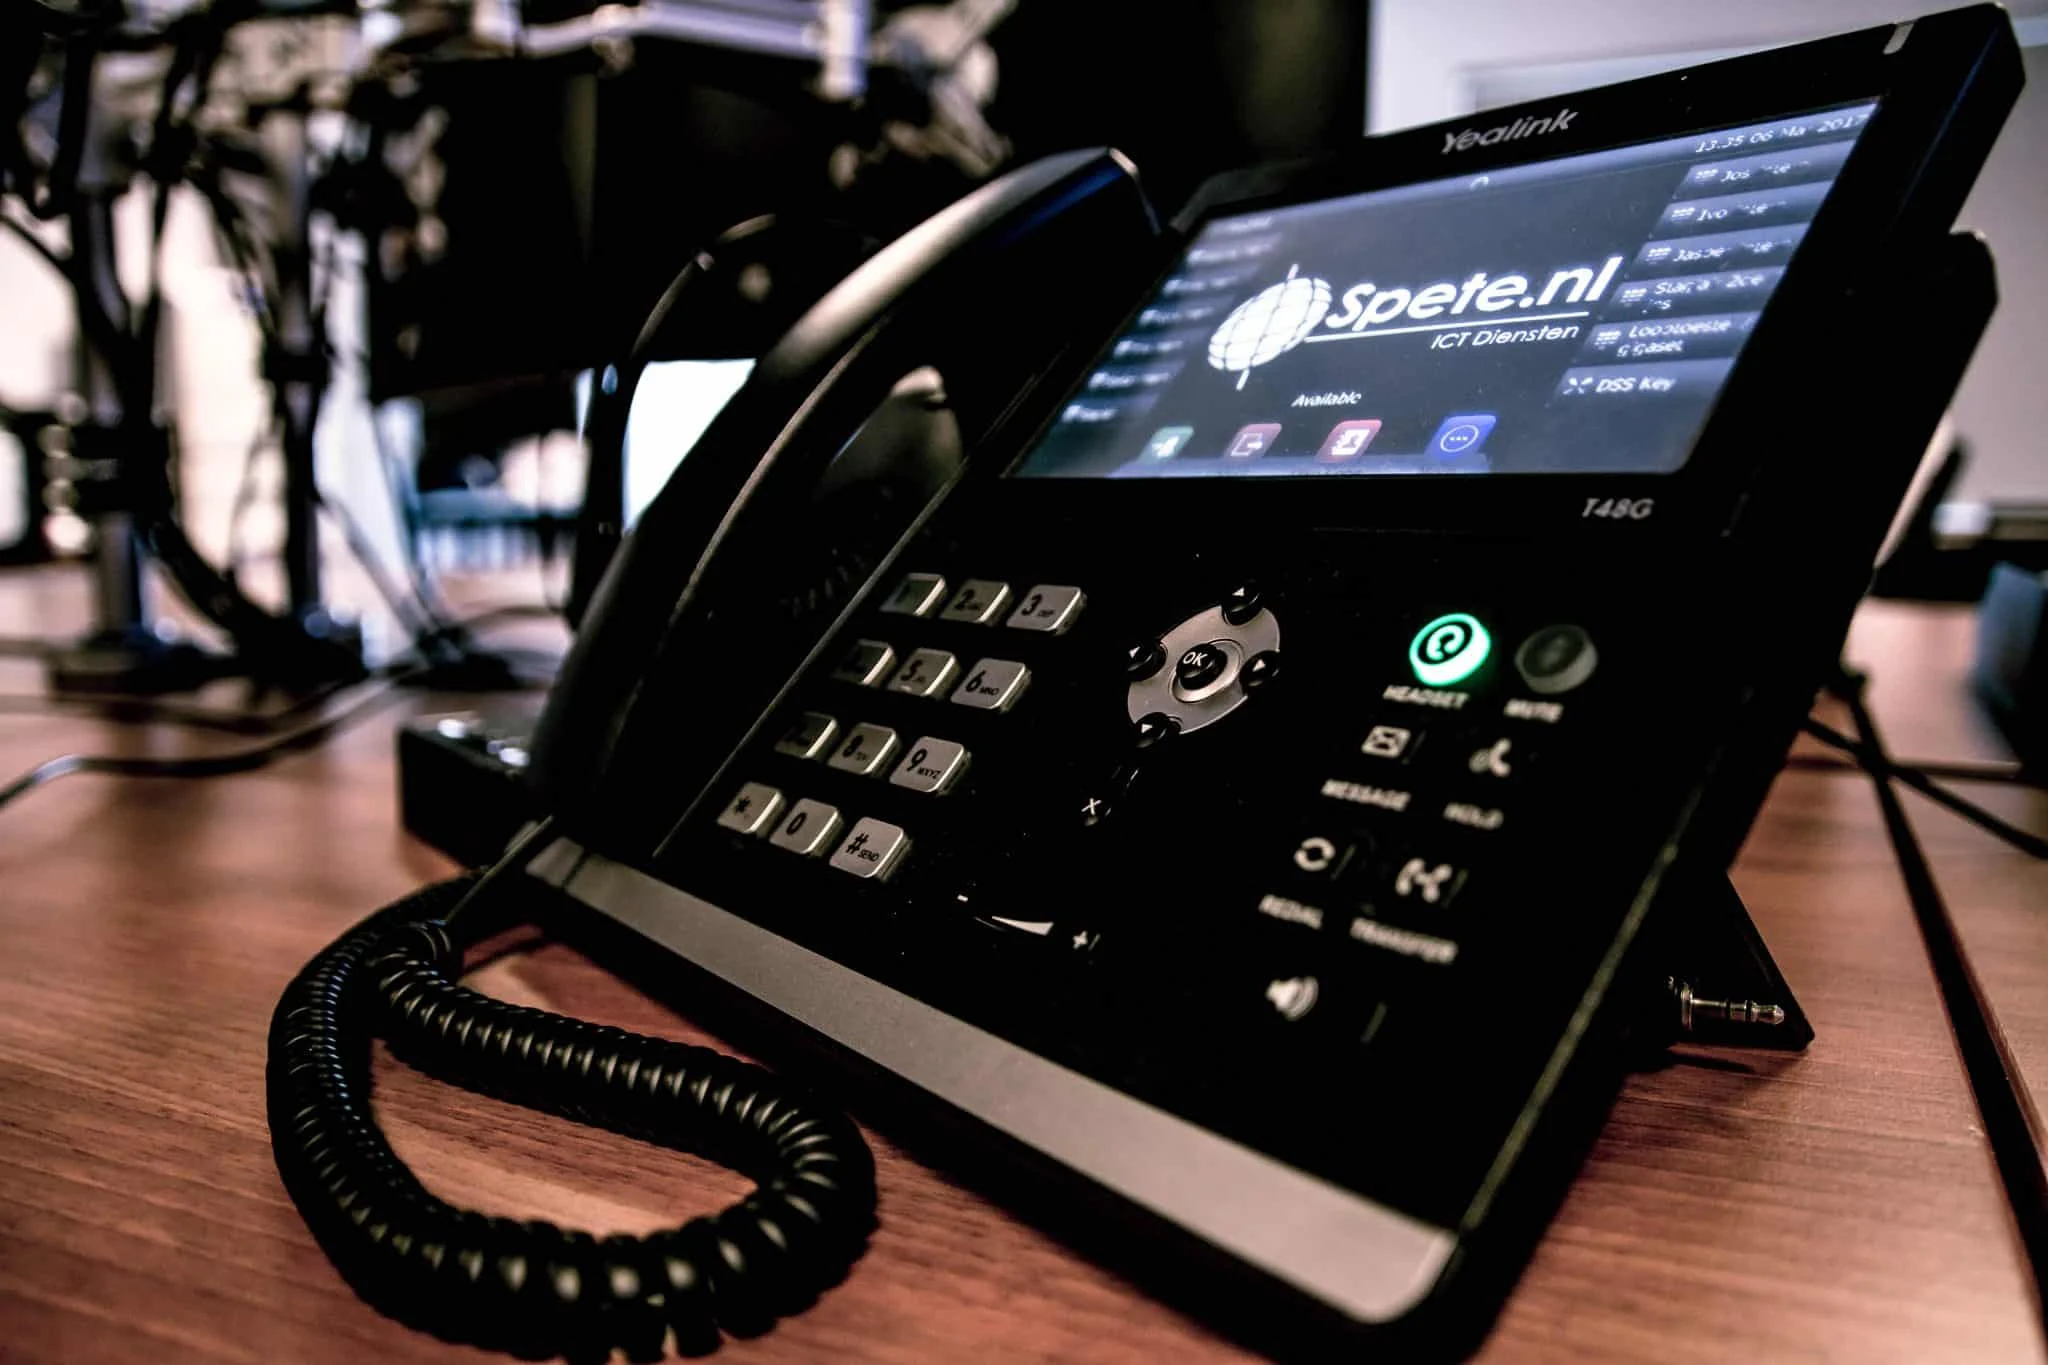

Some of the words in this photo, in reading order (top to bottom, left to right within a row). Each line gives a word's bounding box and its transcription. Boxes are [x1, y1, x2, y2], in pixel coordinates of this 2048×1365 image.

[1440, 108, 1579, 154] Yealink
[1325, 255, 1625, 332] Spete.nl
[1431, 332, 1472, 351] ICT
[1471, 323, 1580, 348] Diensten
[1596, 376, 1637, 393] DSS
[1582, 497, 1655, 520] T48G
[953, 588, 975, 611] 2
[1020, 593, 1043, 616] 3
[900, 658, 923, 682] 5
[1182, 651, 1208, 667] OK
[965, 669, 987, 693] 6
[843, 734, 864, 759] 8
[905, 748, 928, 773] 9
[786, 812, 807, 836] 0
